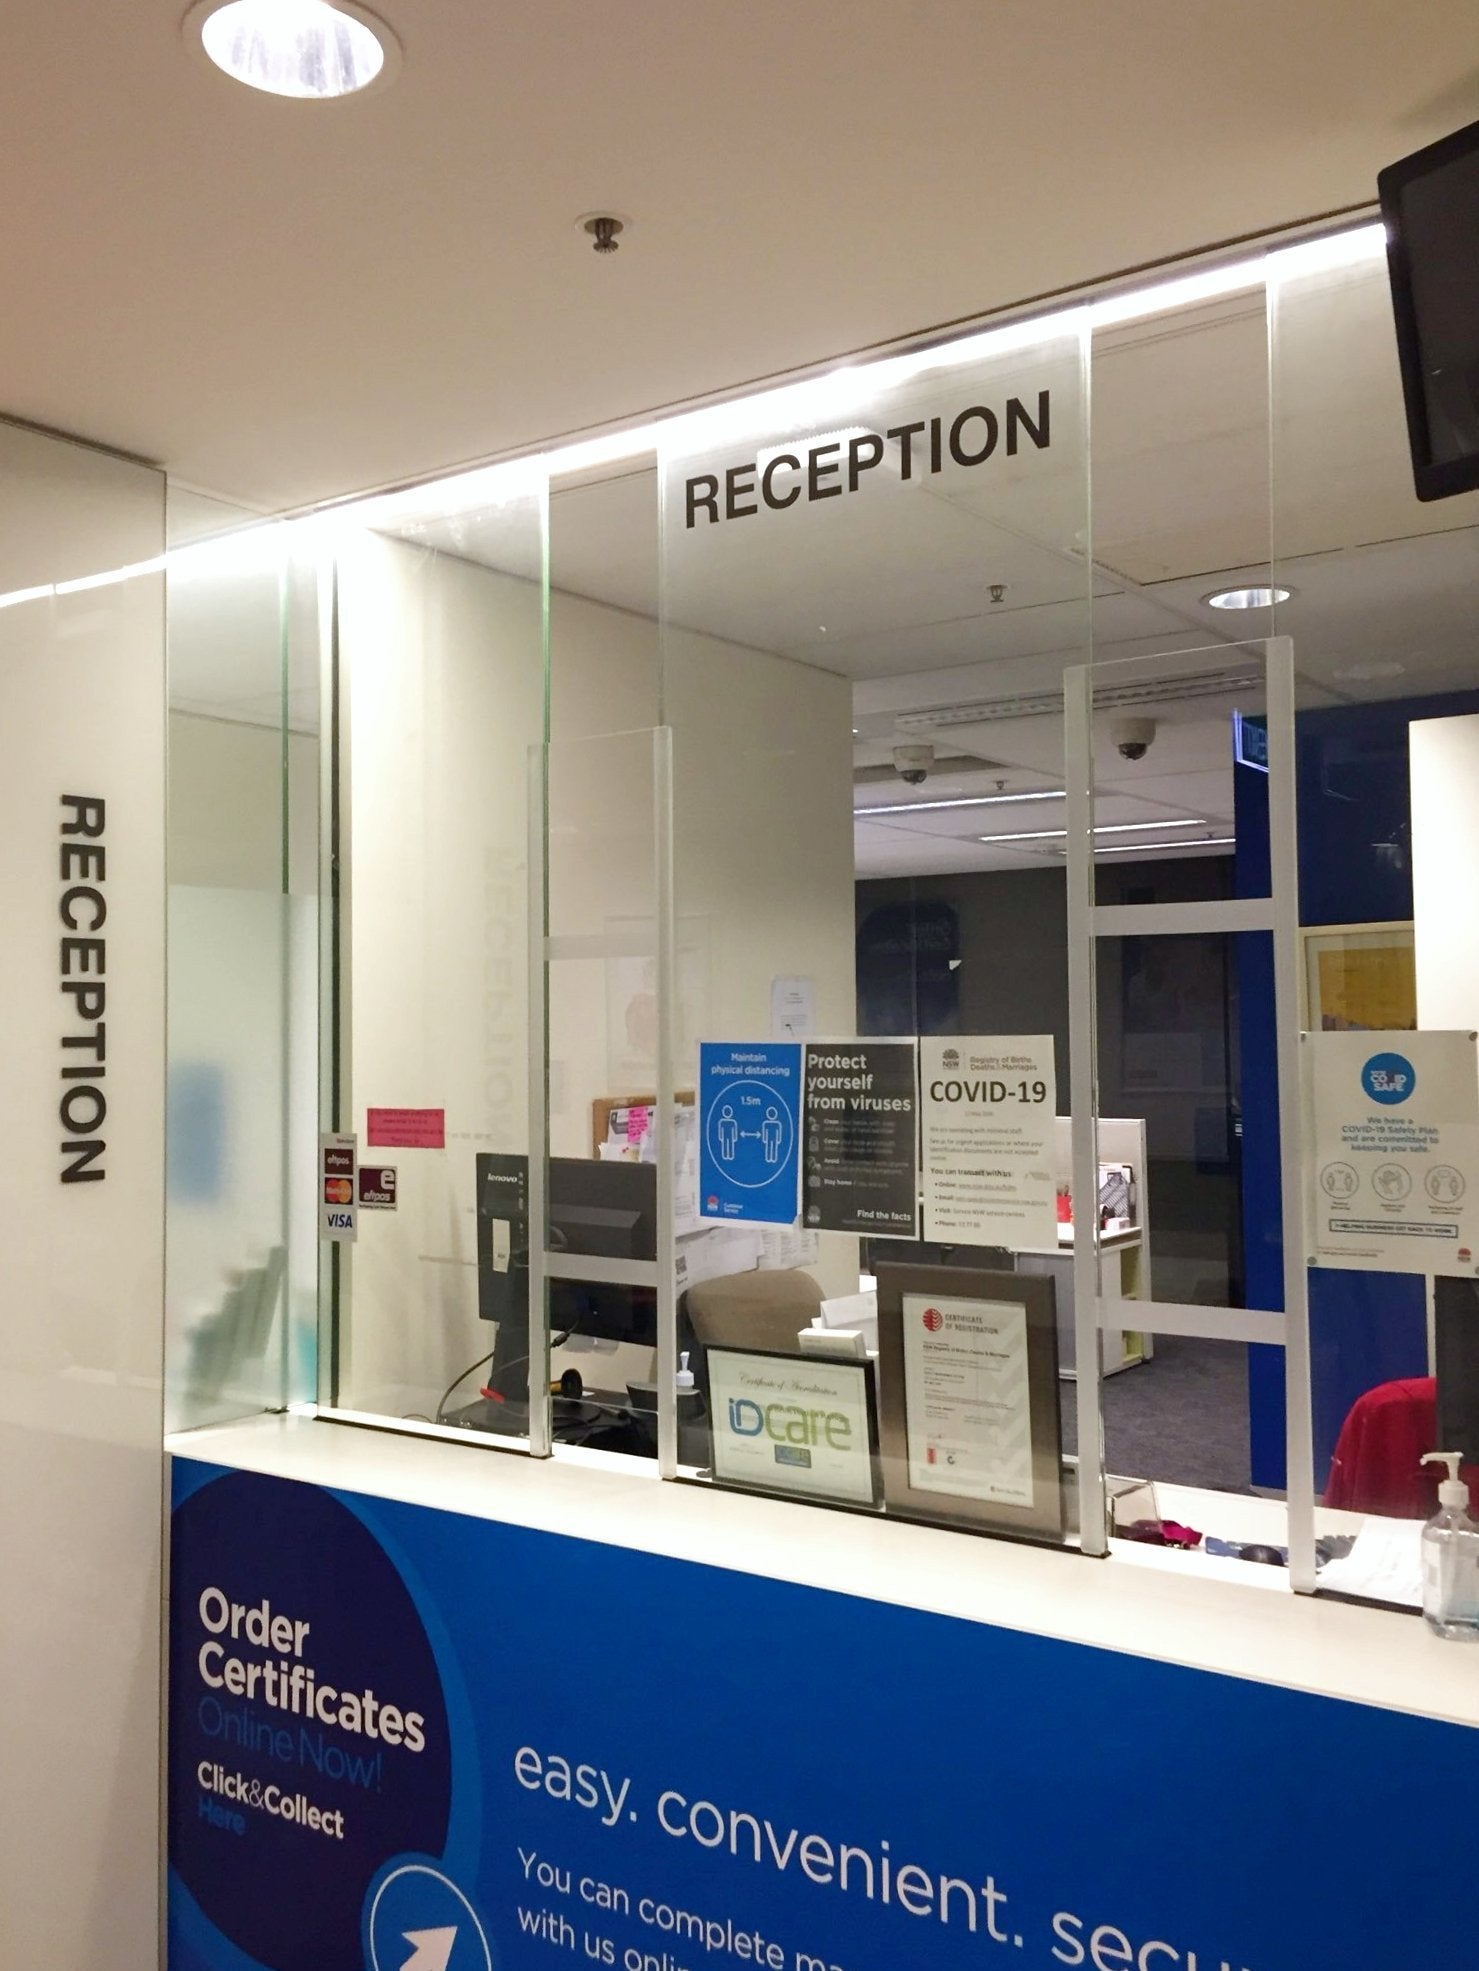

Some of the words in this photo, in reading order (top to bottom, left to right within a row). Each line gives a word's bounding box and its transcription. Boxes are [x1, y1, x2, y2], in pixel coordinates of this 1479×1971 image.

[686, 390, 1050, 529] RECEPTION
[60, 794, 107, 1184] RECEPTION
[731, 1053, 767, 1063] Maintain
[808, 1053, 867, 1069] Protect
[969, 1056, 1000, 1064] Registry
[711, 1065, 743, 1076] physical
[744, 1065, 790, 1077] distancing
[970, 1063, 995, 1071] Deaths
[1002, 1064, 1038, 1072] Marriages
[807, 1073, 874, 1092] yourself
[1373, 1083, 1405, 1092] SAFE
[930, 1081, 1047, 1103] COVID-19
[741, 1096, 761, 1106] 1.5m
[807, 1094, 845, 1109] from
[851, 1095, 912, 1112] viruses
[1367, 1116, 1382, 1124] We
[1342, 1125, 1384, 1134] COVID-19
[1388, 1126, 1417, 1136] Safety
[1418, 1127, 1439, 1135] Plan
[1341, 1135, 1359, 1143] and
[1378, 1136, 1428, 1145] committed
[1351, 1144, 1388, 1153] keeping
[1390, 1146, 1408, 1154] you
[327, 1154, 350, 1166] eftpos
[487, 1173, 518, 1183] lenovo
[364, 1190, 391, 1202] eftpos
[328, 1214, 353, 1228] VISA
[857, 1209, 875, 1218] Find
[875, 1211, 890, 1220] the
[891, 1212, 912, 1221] facts
[944, 1313, 984, 1324] CERTIFICATE
[199, 1586, 310, 1657] Order
[199, 1641, 426, 1753] Certificates
[199, 1696, 294, 1762] Online
[301, 1732, 383, 1793] Now!
[514, 1746, 638, 1827] easy.
[198, 1761, 345, 1839] Click&Collect
[198, 1801, 247, 1837] Here
[656, 1791, 1023, 1948] convenient.
[1052, 1911, 1250, 1971] sec
[517, 1847, 571, 1894] You
[579, 1874, 629, 1916] can
[638, 1898, 785, 1971] complete
[517, 1906, 576, 1949] with
[584, 1931, 616, 1965] us
[624, 1948, 689, 1971] onli
